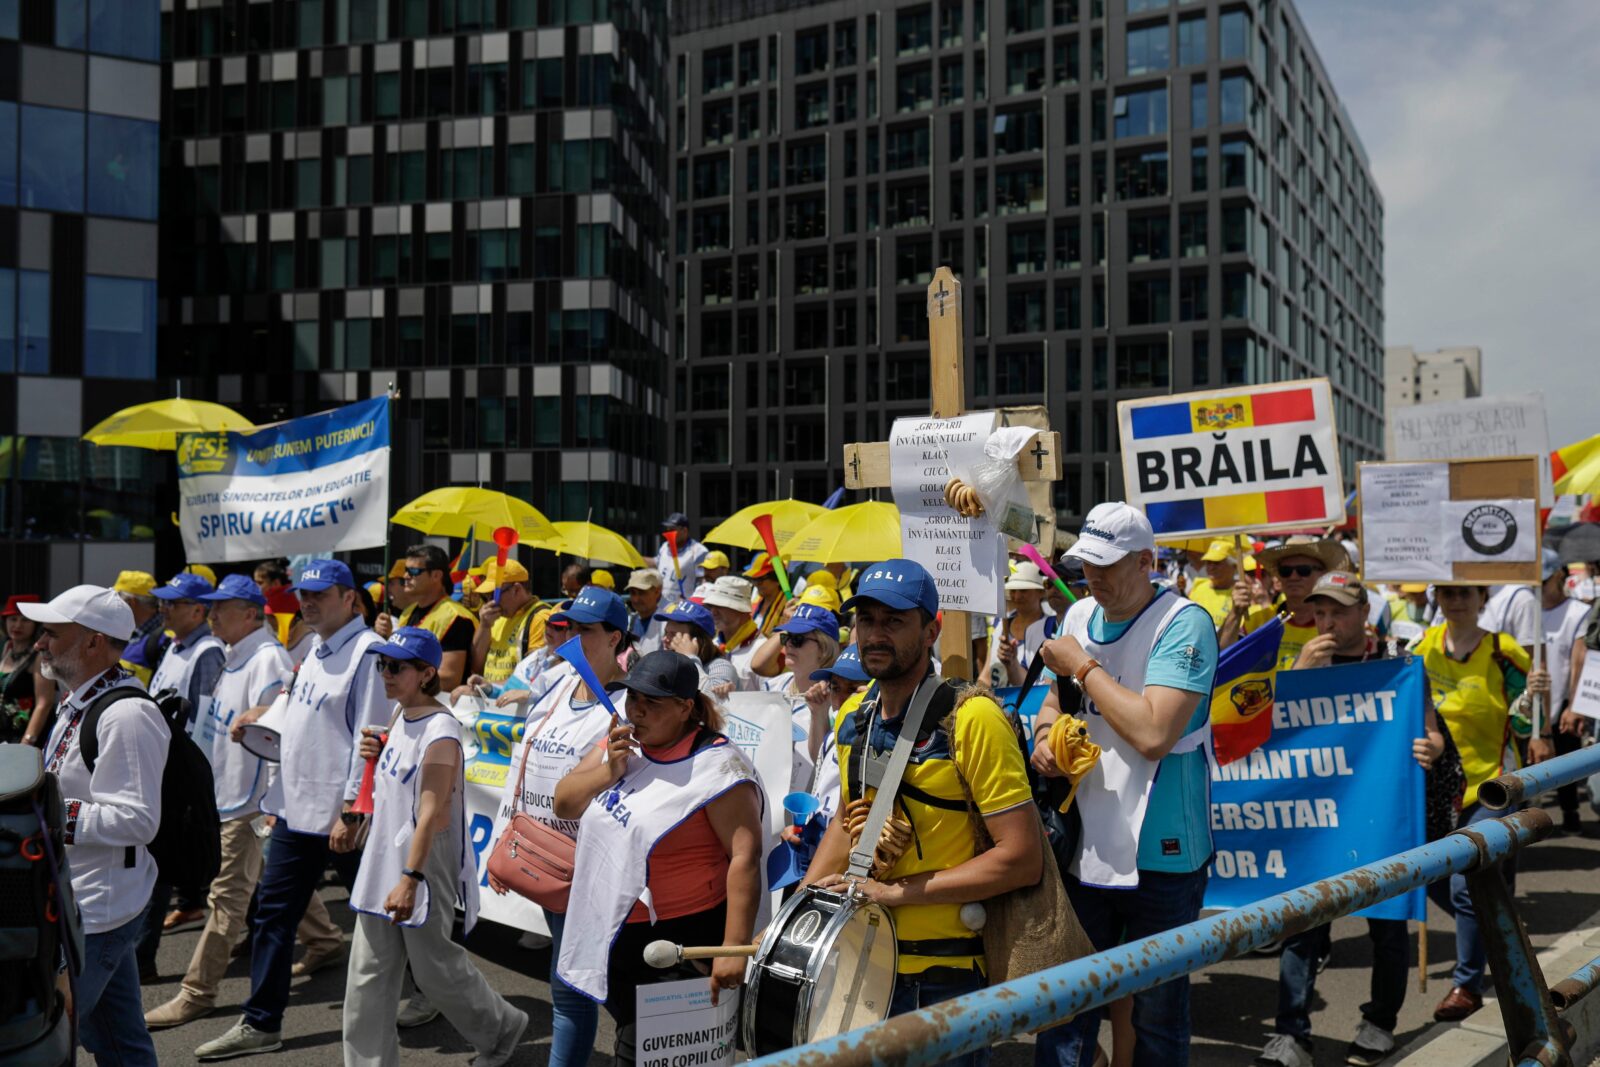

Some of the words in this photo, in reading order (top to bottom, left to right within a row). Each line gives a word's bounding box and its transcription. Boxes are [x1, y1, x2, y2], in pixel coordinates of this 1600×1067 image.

[922, 449, 949, 461] KLAUS
[1136, 432, 1328, 494] BRĂILA
[221, 487, 304, 502] SINDICATELOR
[304, 485, 323, 498] DIN
[323, 469, 372, 494] EDUCAȚIE
[922, 497, 945, 508] KELE
[1463, 505, 1517, 528] DEMNITATE
[935, 546, 961, 555] KLAUS
[865, 570, 904, 583] FSLI
[1273, 690, 1397, 730] ENDENT
[1265, 850, 1287, 879] 4
[688, 998, 712, 1006] VRANC
[642, 1025, 724, 1053] GUVERNANȚII
